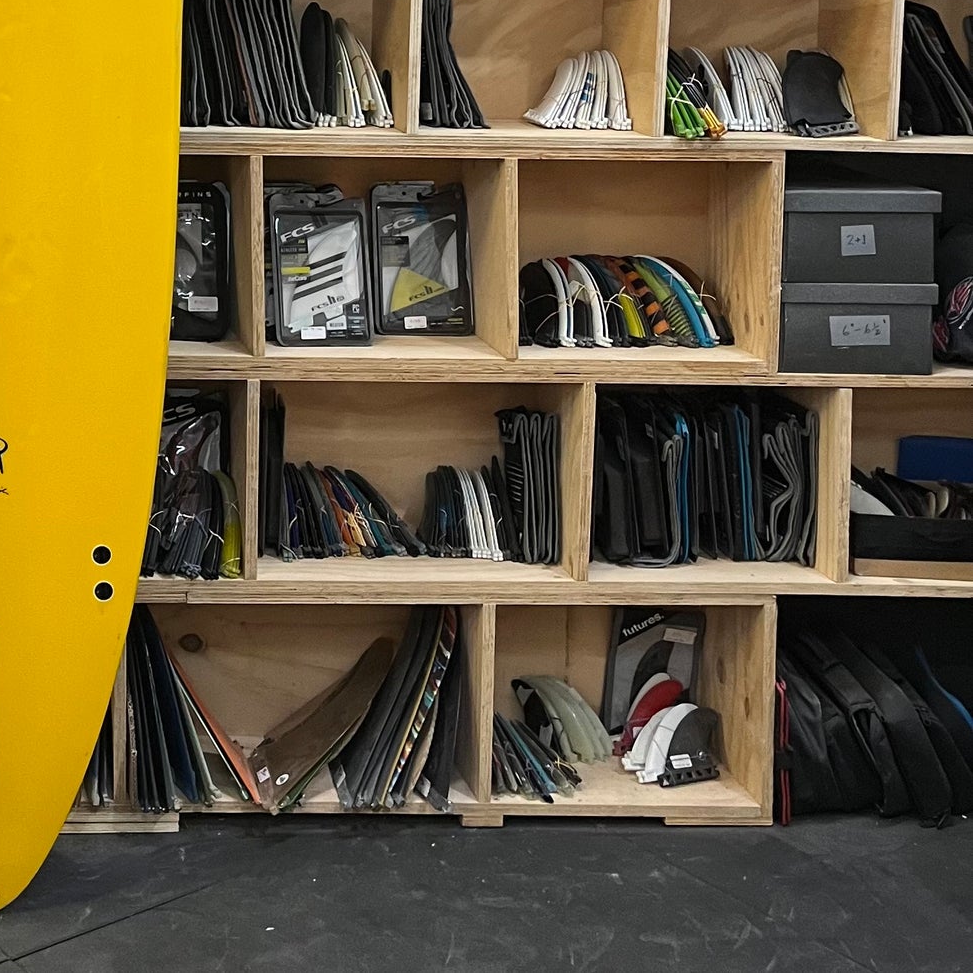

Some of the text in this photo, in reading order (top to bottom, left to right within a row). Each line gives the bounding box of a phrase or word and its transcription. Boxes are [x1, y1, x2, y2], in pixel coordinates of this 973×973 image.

[280, 223, 315, 243] FCS
[381, 215, 416, 234] FCS
[846, 234, 867, 245] 2+1
[409, 292, 426, 301] FCS
[311, 303, 329, 312] FCS
[163, 403, 197, 422] CS
[622, 611, 665, 637] futures.
